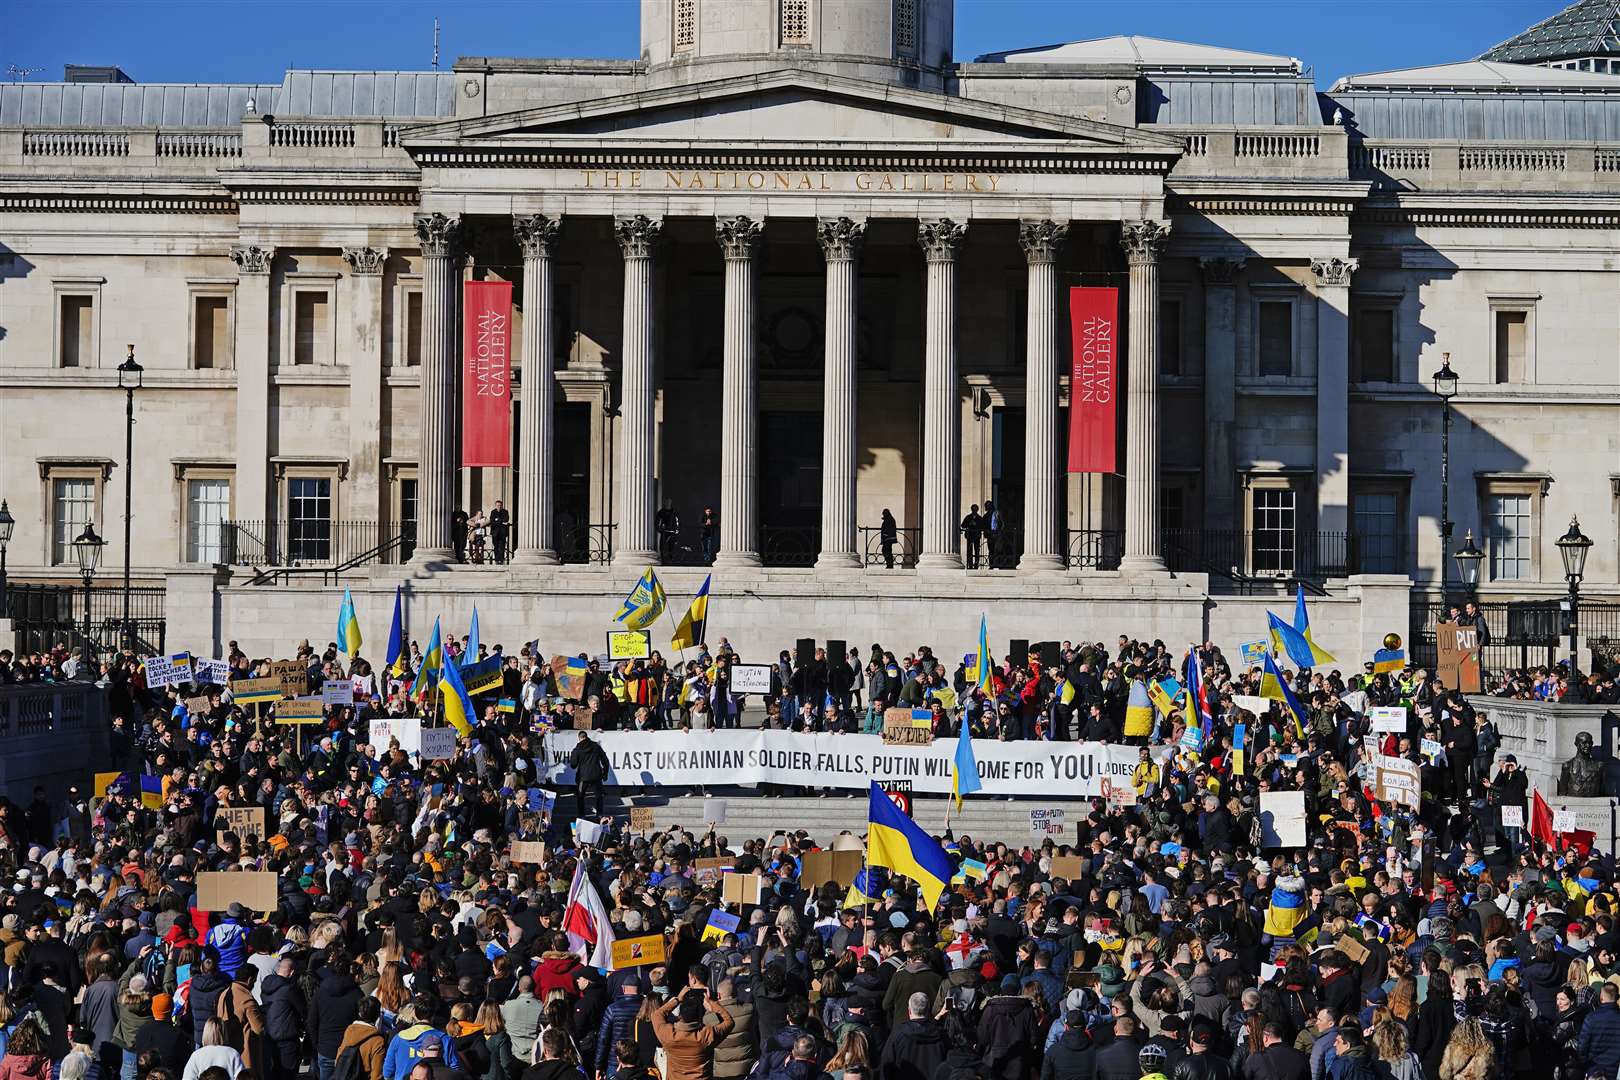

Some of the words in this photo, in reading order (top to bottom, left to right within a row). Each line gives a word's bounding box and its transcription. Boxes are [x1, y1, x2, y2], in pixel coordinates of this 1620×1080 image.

[580, 169, 642, 188] THE
[666, 171, 831, 190] NATIONAL
[855, 173, 1003, 191] GALLERY
[477, 310, 490, 396] NATIONAL
[491, 311, 506, 397] GALLERY
[1083, 316, 1096, 402] NATIONAL
[1096, 317, 1111, 403] GALLERY
[1456, 630, 1477, 651] PUT
[148, 658, 164, 666] SEND
[148, 663, 171, 671] ROCKET
[149, 666, 188, 678] LAUNCHERS
[163, 672, 191, 682] RHETORIC
[613, 751, 652, 770] LAST
[656, 750, 744, 770] UKRAINIAN
[749, 750, 811, 770] SOLDIER
[818, 753, 868, 775] FALLS,
[873, 756, 919, 776] PUTIN
[924, 758, 952, 777] WIL
[976, 760, 1010, 779] OME
[1015, 761, 1044, 779] FOR
[1050, 754, 1093, 780] YOU
[1098, 762, 1134, 776] LADIES
[225, 809, 254, 823] НЕТ
[232, 823, 263, 838] ОЙНЕ
[1033, 819, 1050, 830] STOP
[1046, 824, 1064, 834] PUTIN
